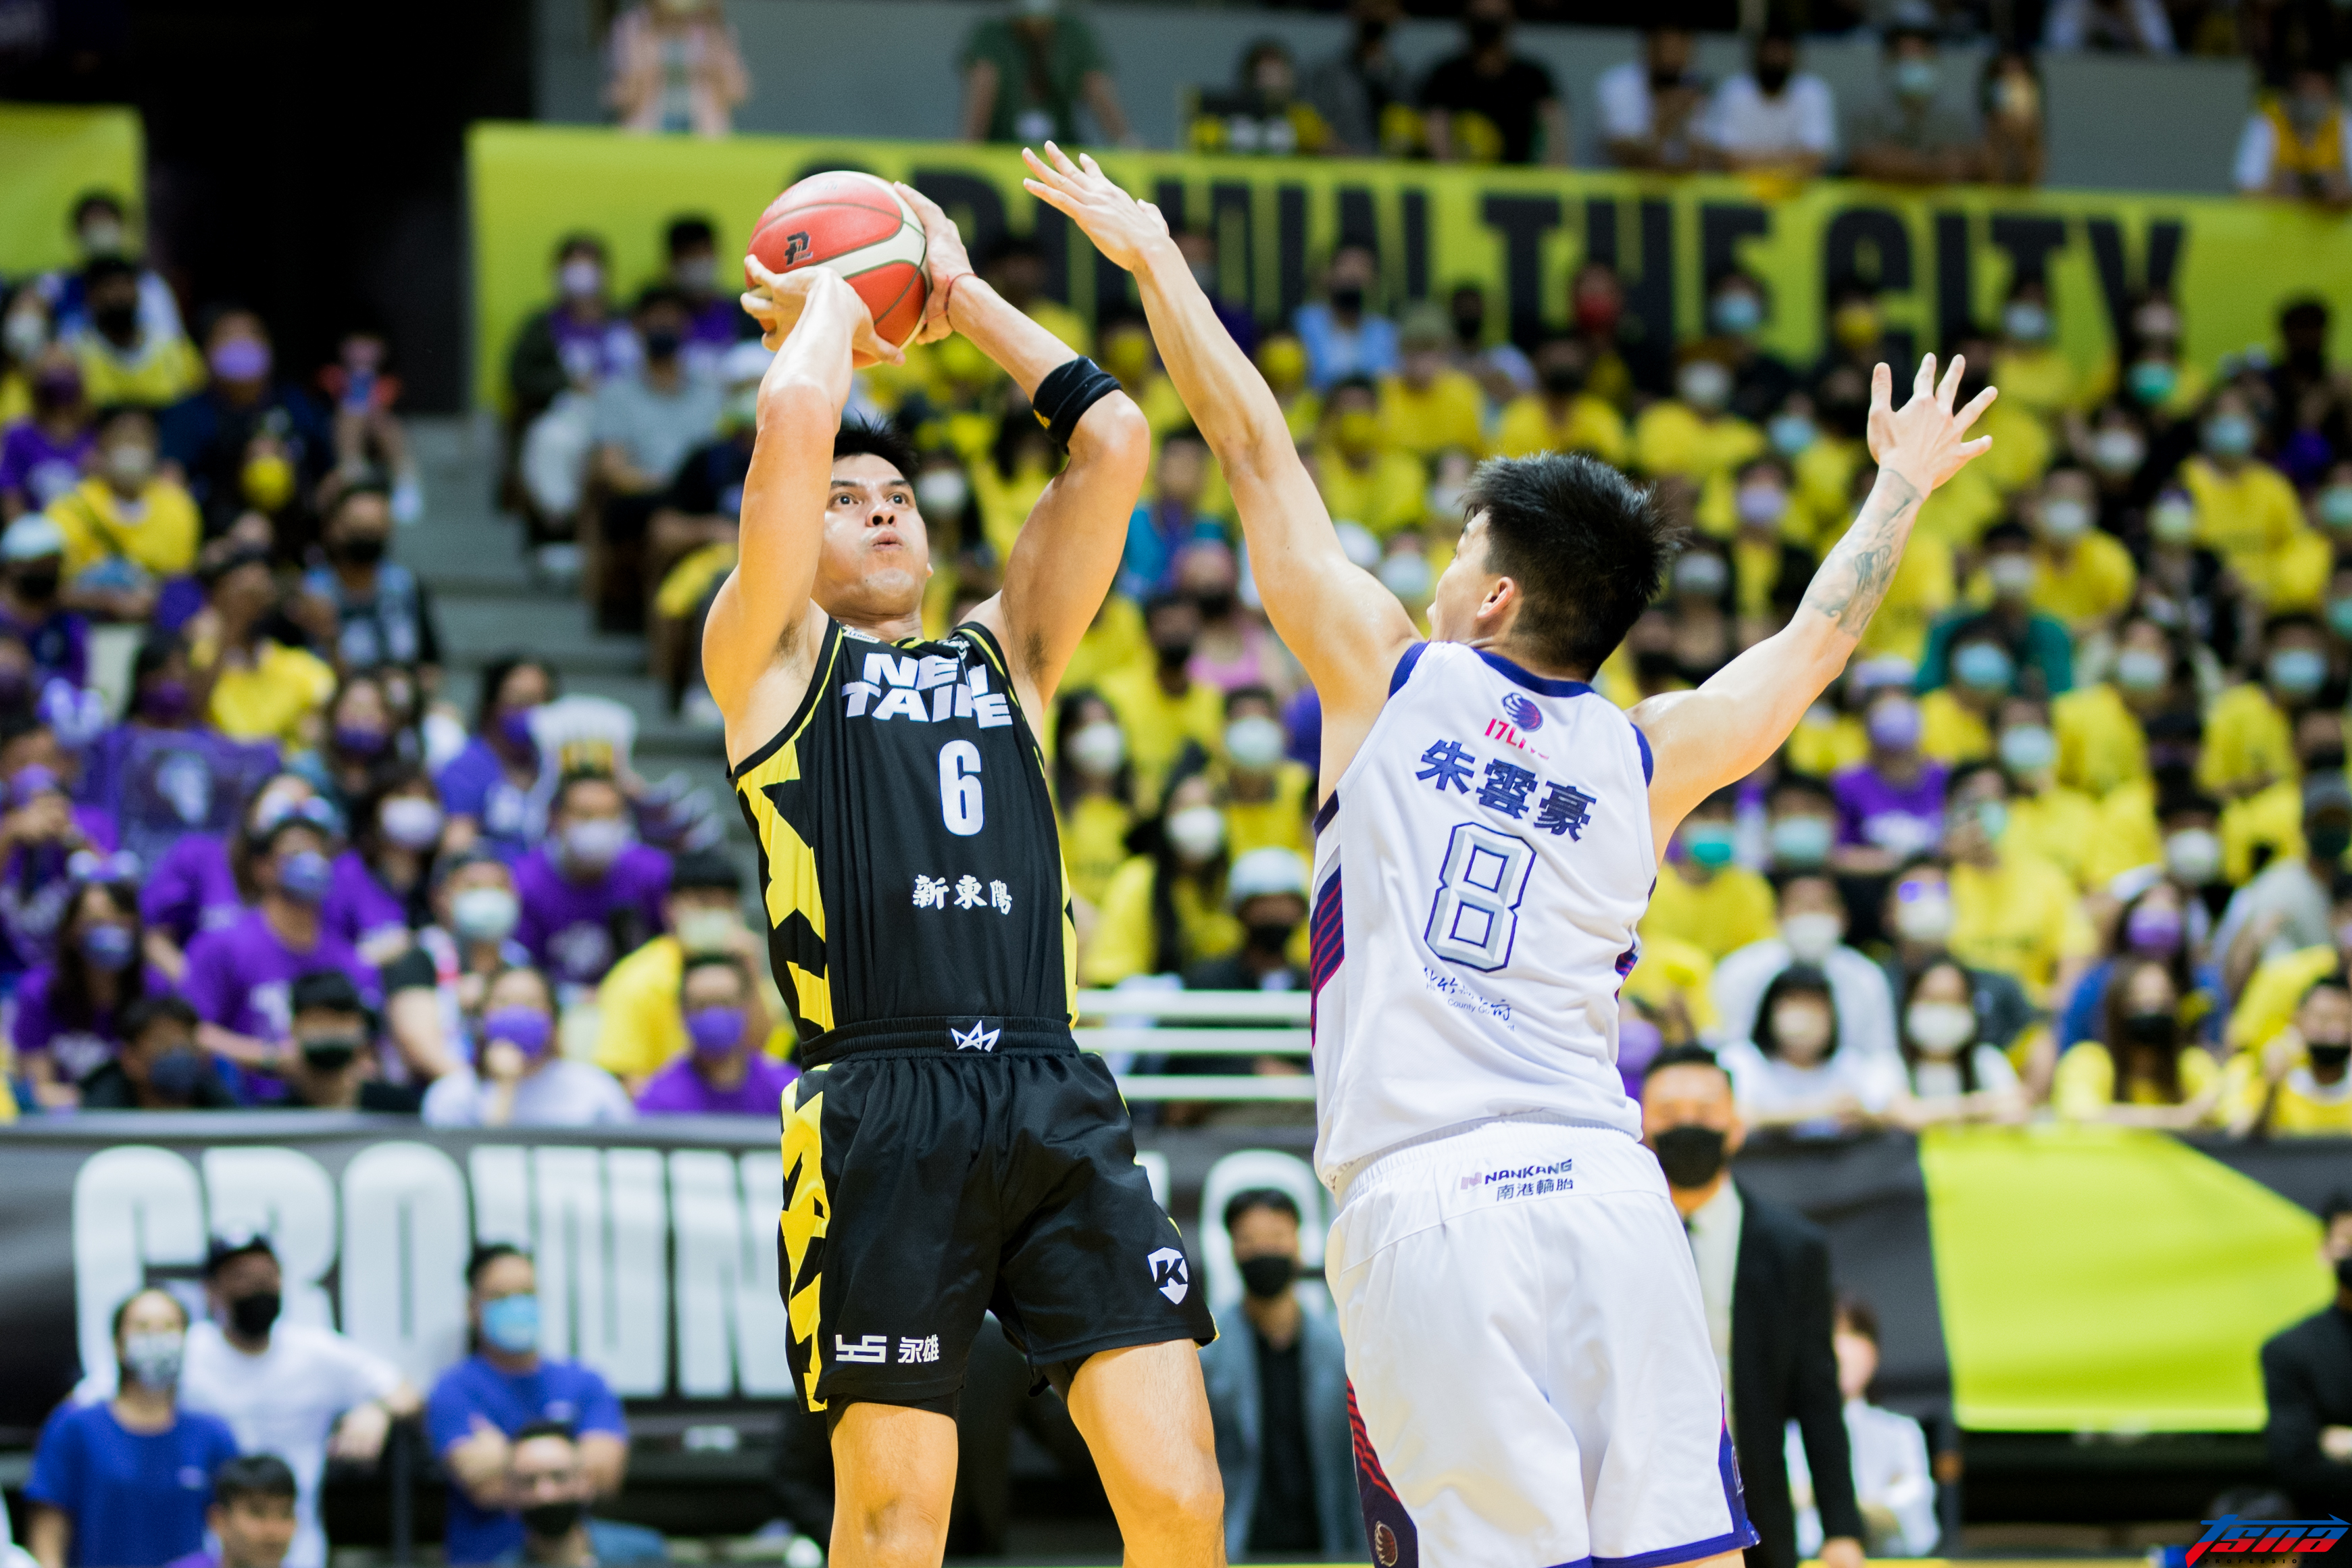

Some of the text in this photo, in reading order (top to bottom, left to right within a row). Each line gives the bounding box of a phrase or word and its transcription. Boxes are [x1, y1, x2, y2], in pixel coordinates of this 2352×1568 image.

[939, 740, 984, 836] 6
[1416, 738, 1597, 842] 朱雲豪
[912, 874, 1013, 915] 新東陽
[1424, 821, 1536, 973] 8
[1447, 997, 1476, 1013] County
[1484, 1158, 1573, 1186] NANKANG
[1496, 1178, 1573, 1202] 南港輪胎
[897, 1334, 940, 1363] 永雄
